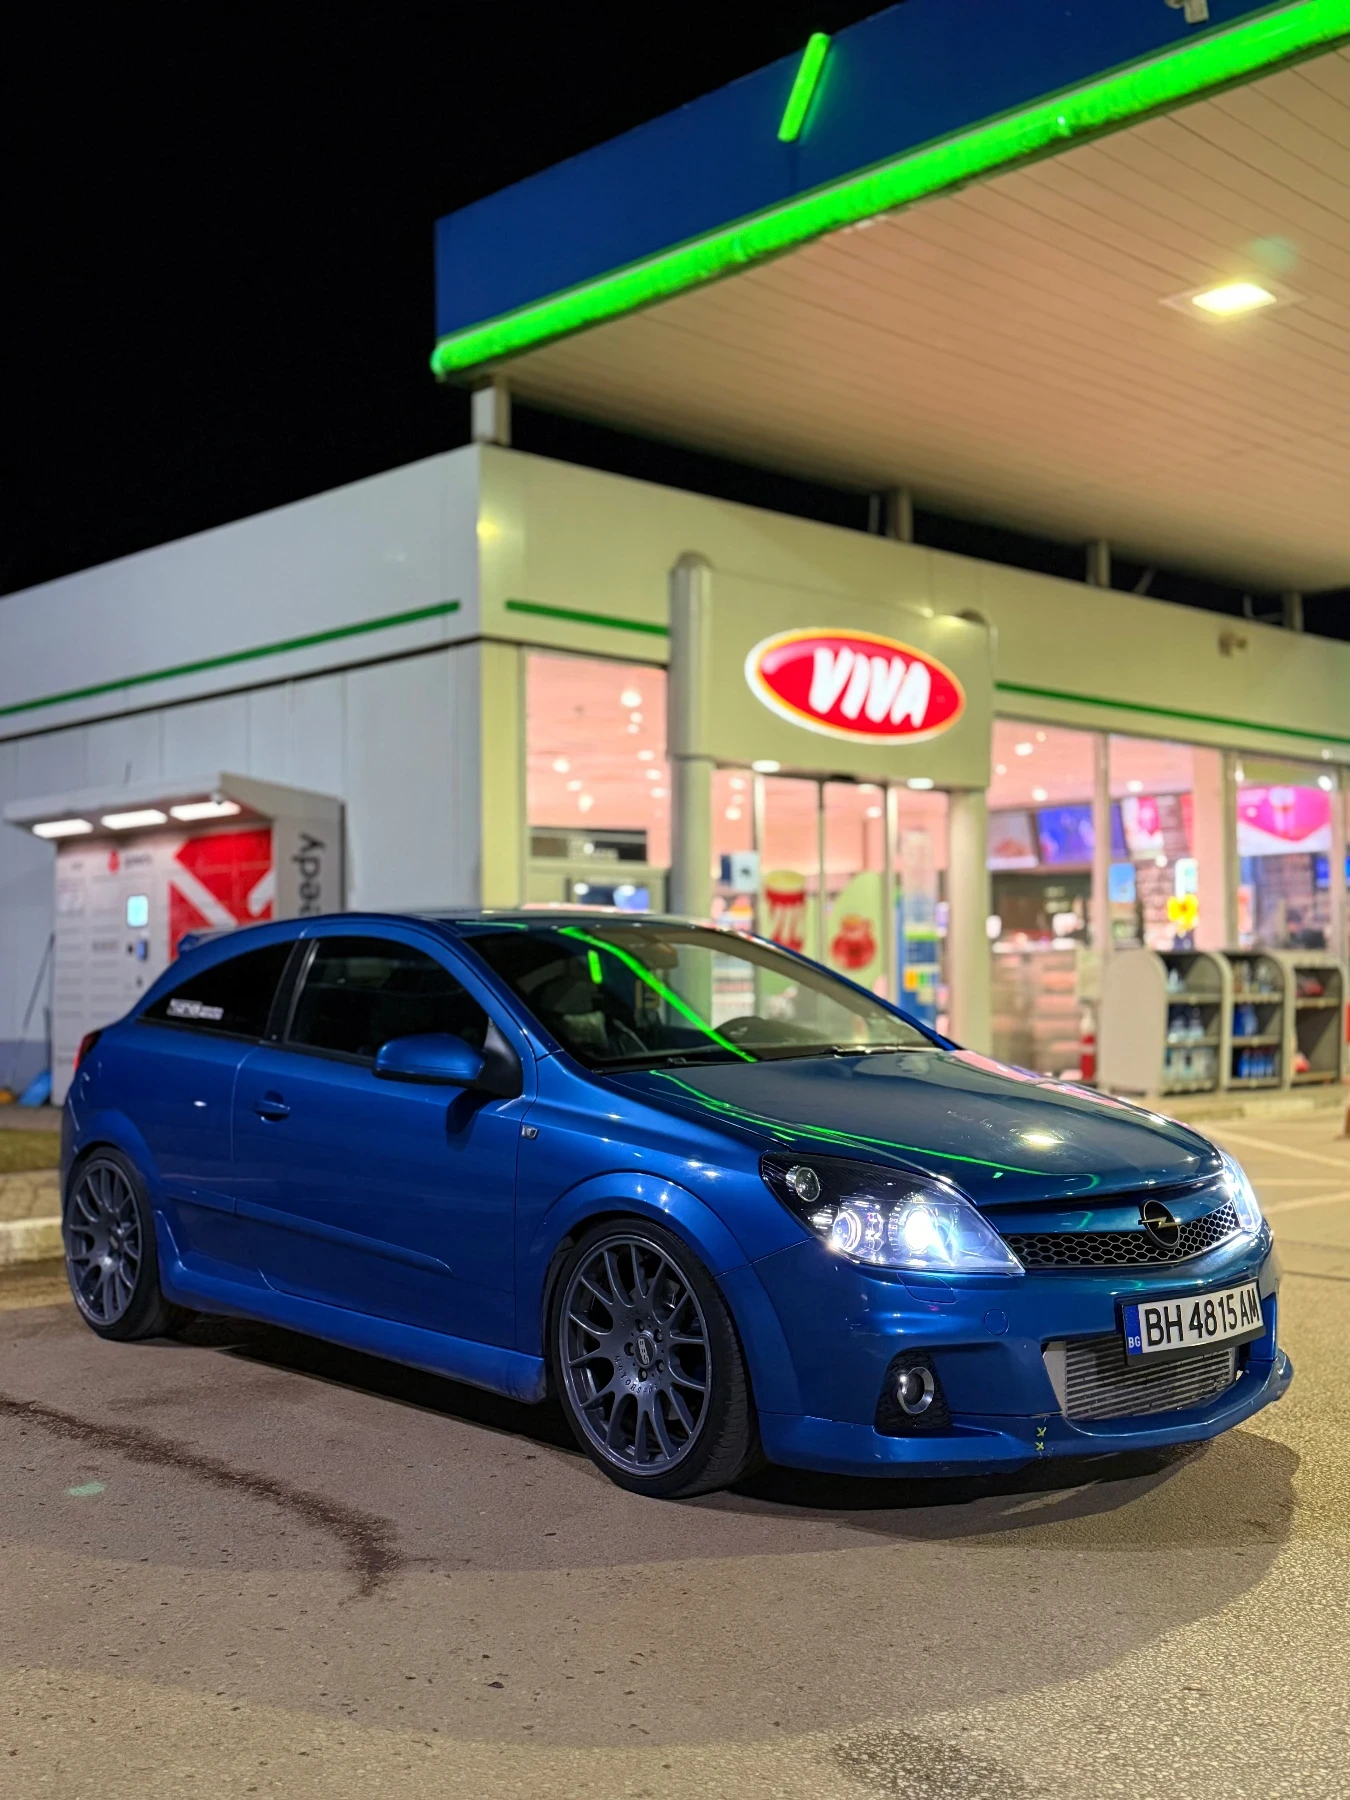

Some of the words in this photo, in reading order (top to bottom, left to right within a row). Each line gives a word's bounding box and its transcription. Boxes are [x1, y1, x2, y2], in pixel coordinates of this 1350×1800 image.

[809, 647, 931, 728] VIVA
[1145, 1304, 1184, 1346] BH
[1189, 1294, 1238, 1339] 4815
[1239, 1288, 1260, 1328] AM
[638, 1338, 650, 1364] BBS
[1128, 1336, 1141, 1349] BG
